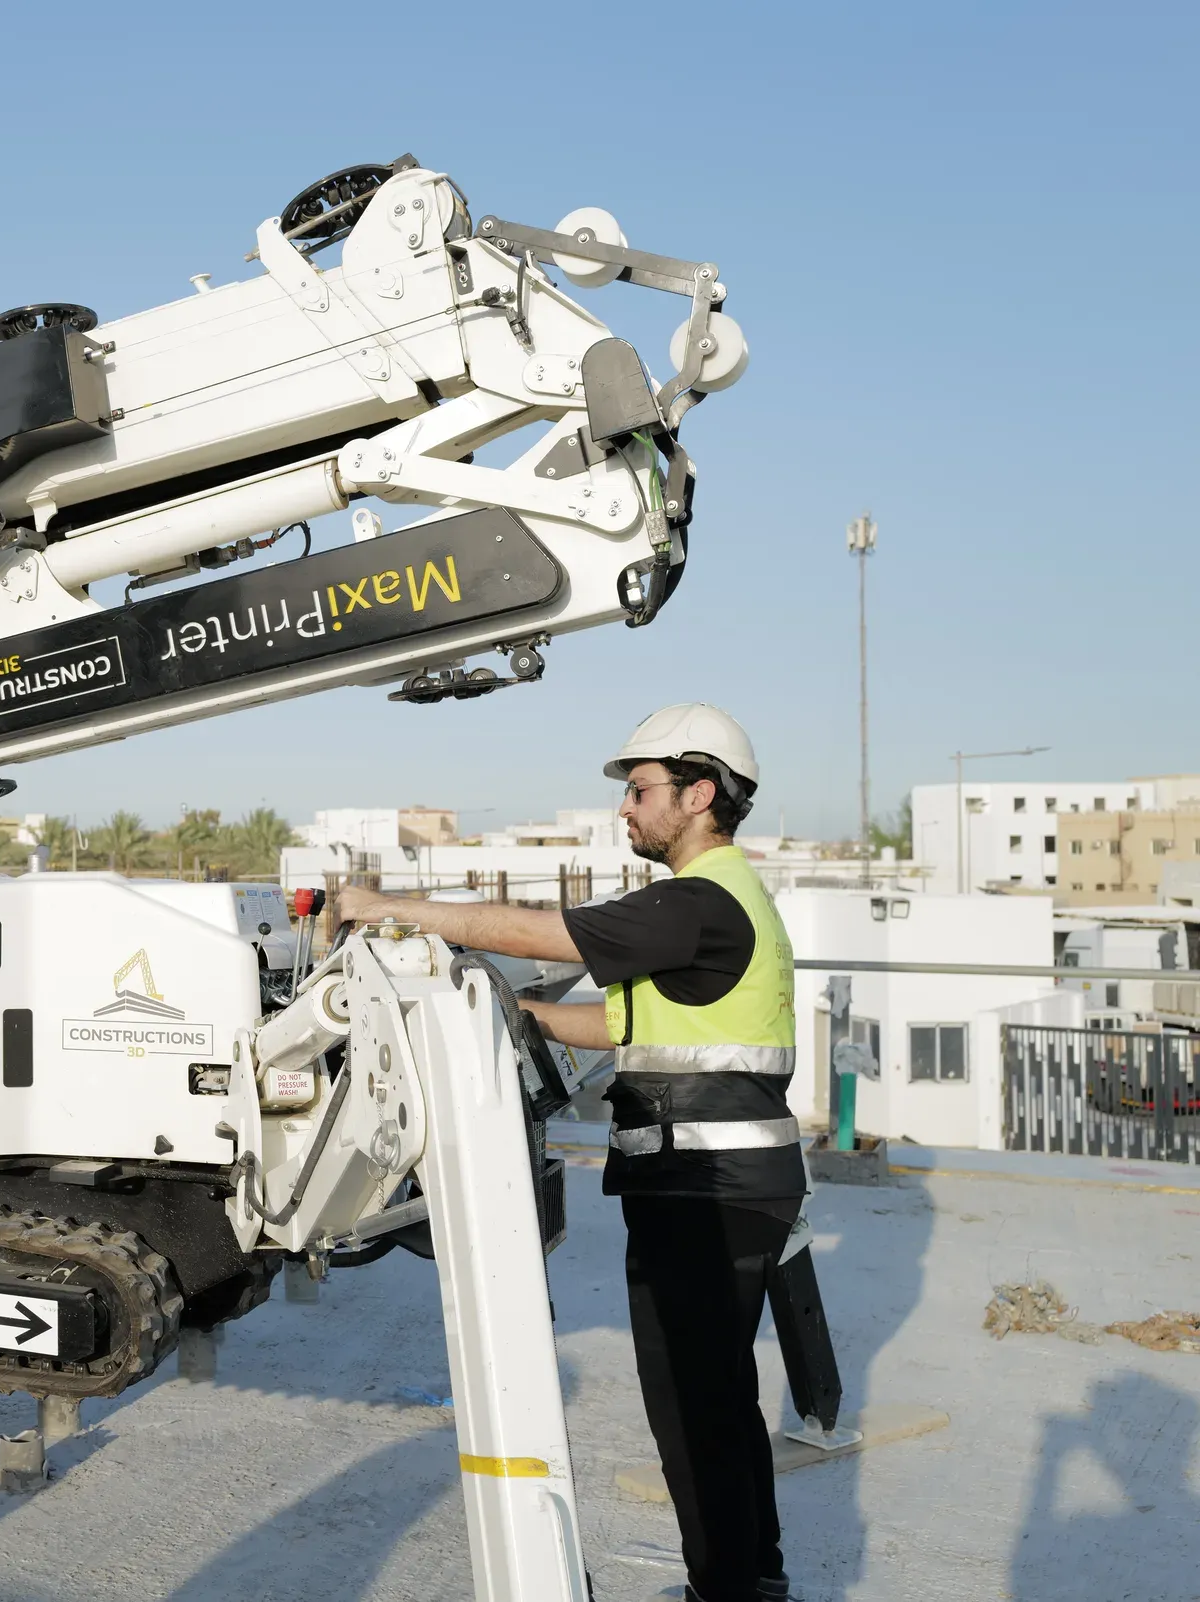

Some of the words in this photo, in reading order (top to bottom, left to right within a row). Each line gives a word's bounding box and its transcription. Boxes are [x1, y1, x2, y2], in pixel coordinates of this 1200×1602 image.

[160, 555, 462, 661] MaxiPrinter
[69, 1028, 206, 1046] CONSTRUCTIONS
[127, 1046, 146, 1058] 3D
[278, 1081, 308, 1089] PRESSURE
